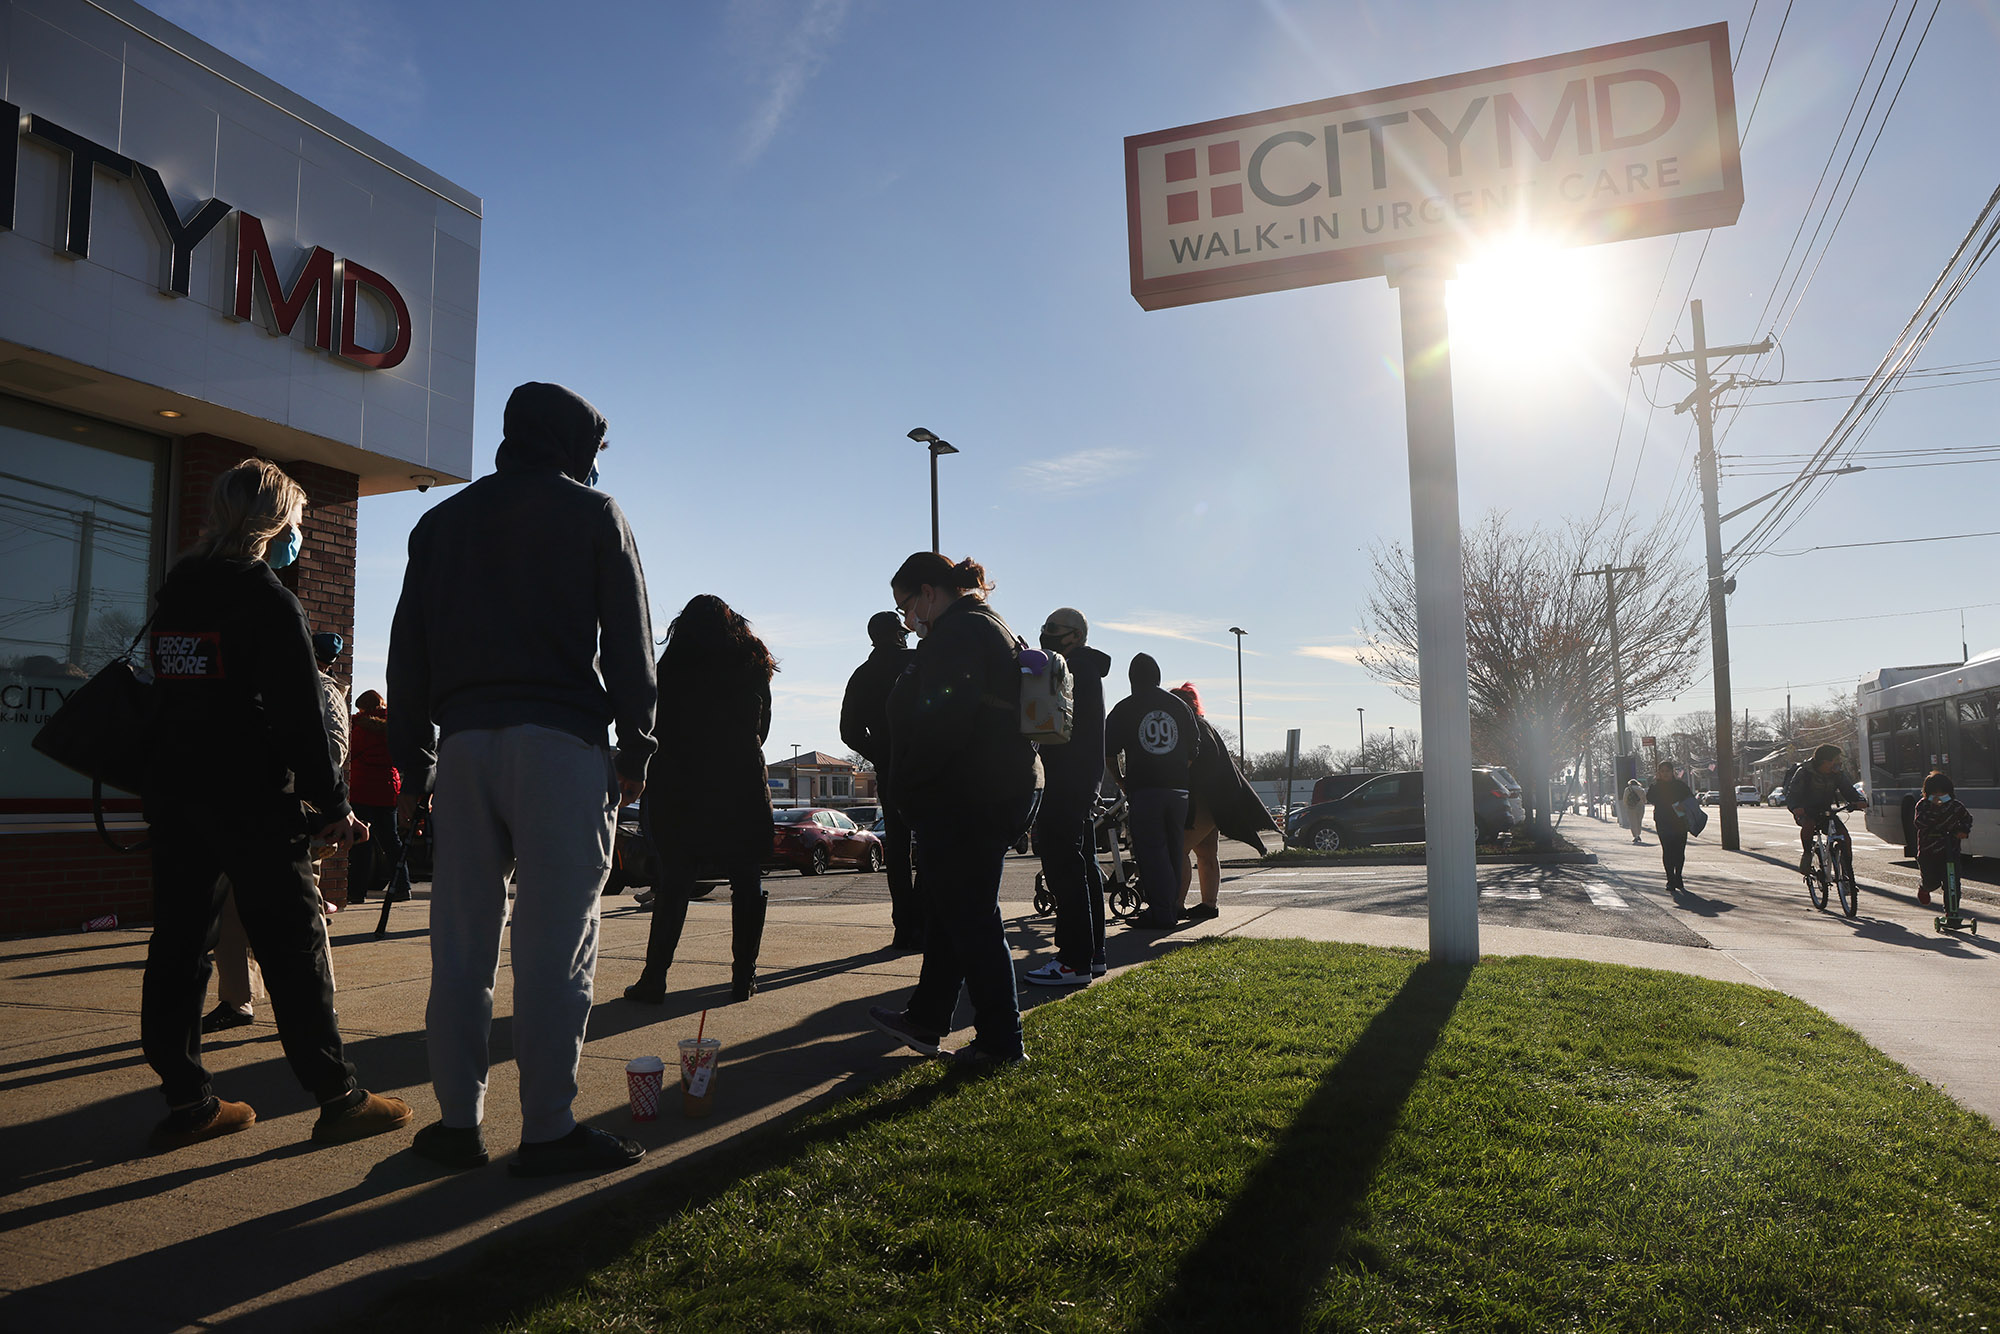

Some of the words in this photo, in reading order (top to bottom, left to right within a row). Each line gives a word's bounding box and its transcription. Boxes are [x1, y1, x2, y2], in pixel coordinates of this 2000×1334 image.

[1248, 68, 1681, 207] CITYMD
[1169, 213, 1340, 264] WALK-IN
[1360, 180, 1536, 234] URGENT
[1559, 157, 1681, 203] CARE
[156, 636, 202, 656] JERSEY
[161, 656, 208, 675] SHORE
[1146, 719, 1172, 746] 99
